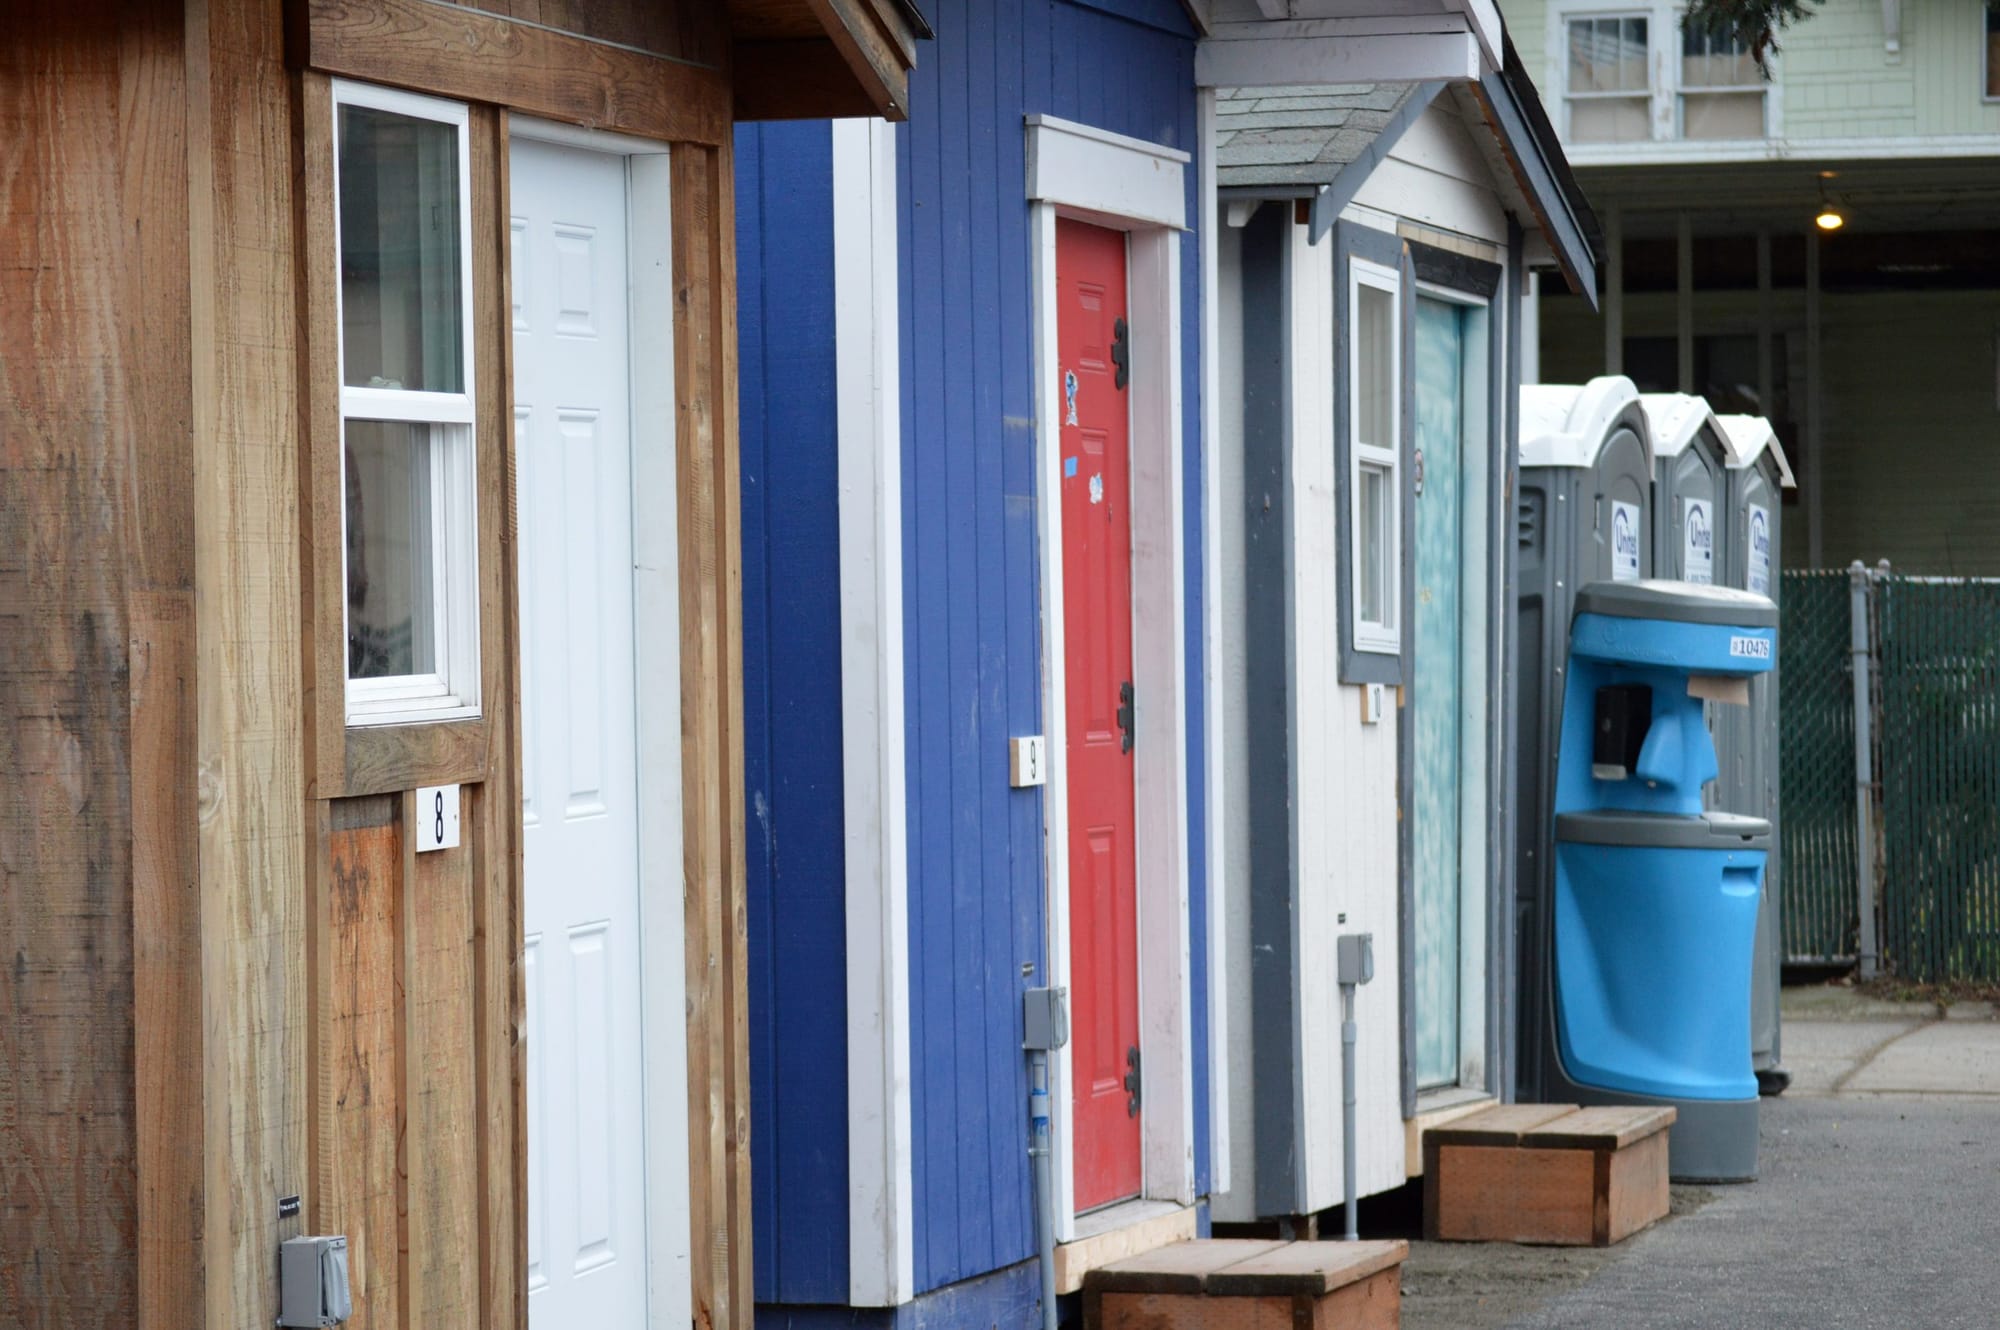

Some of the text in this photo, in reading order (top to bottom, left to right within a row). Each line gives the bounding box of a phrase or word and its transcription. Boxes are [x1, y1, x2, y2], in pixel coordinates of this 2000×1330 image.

[1739, 639, 1769, 657] 10476
[1031, 740, 1036, 780] 9
[435, 790, 444, 844] 8
